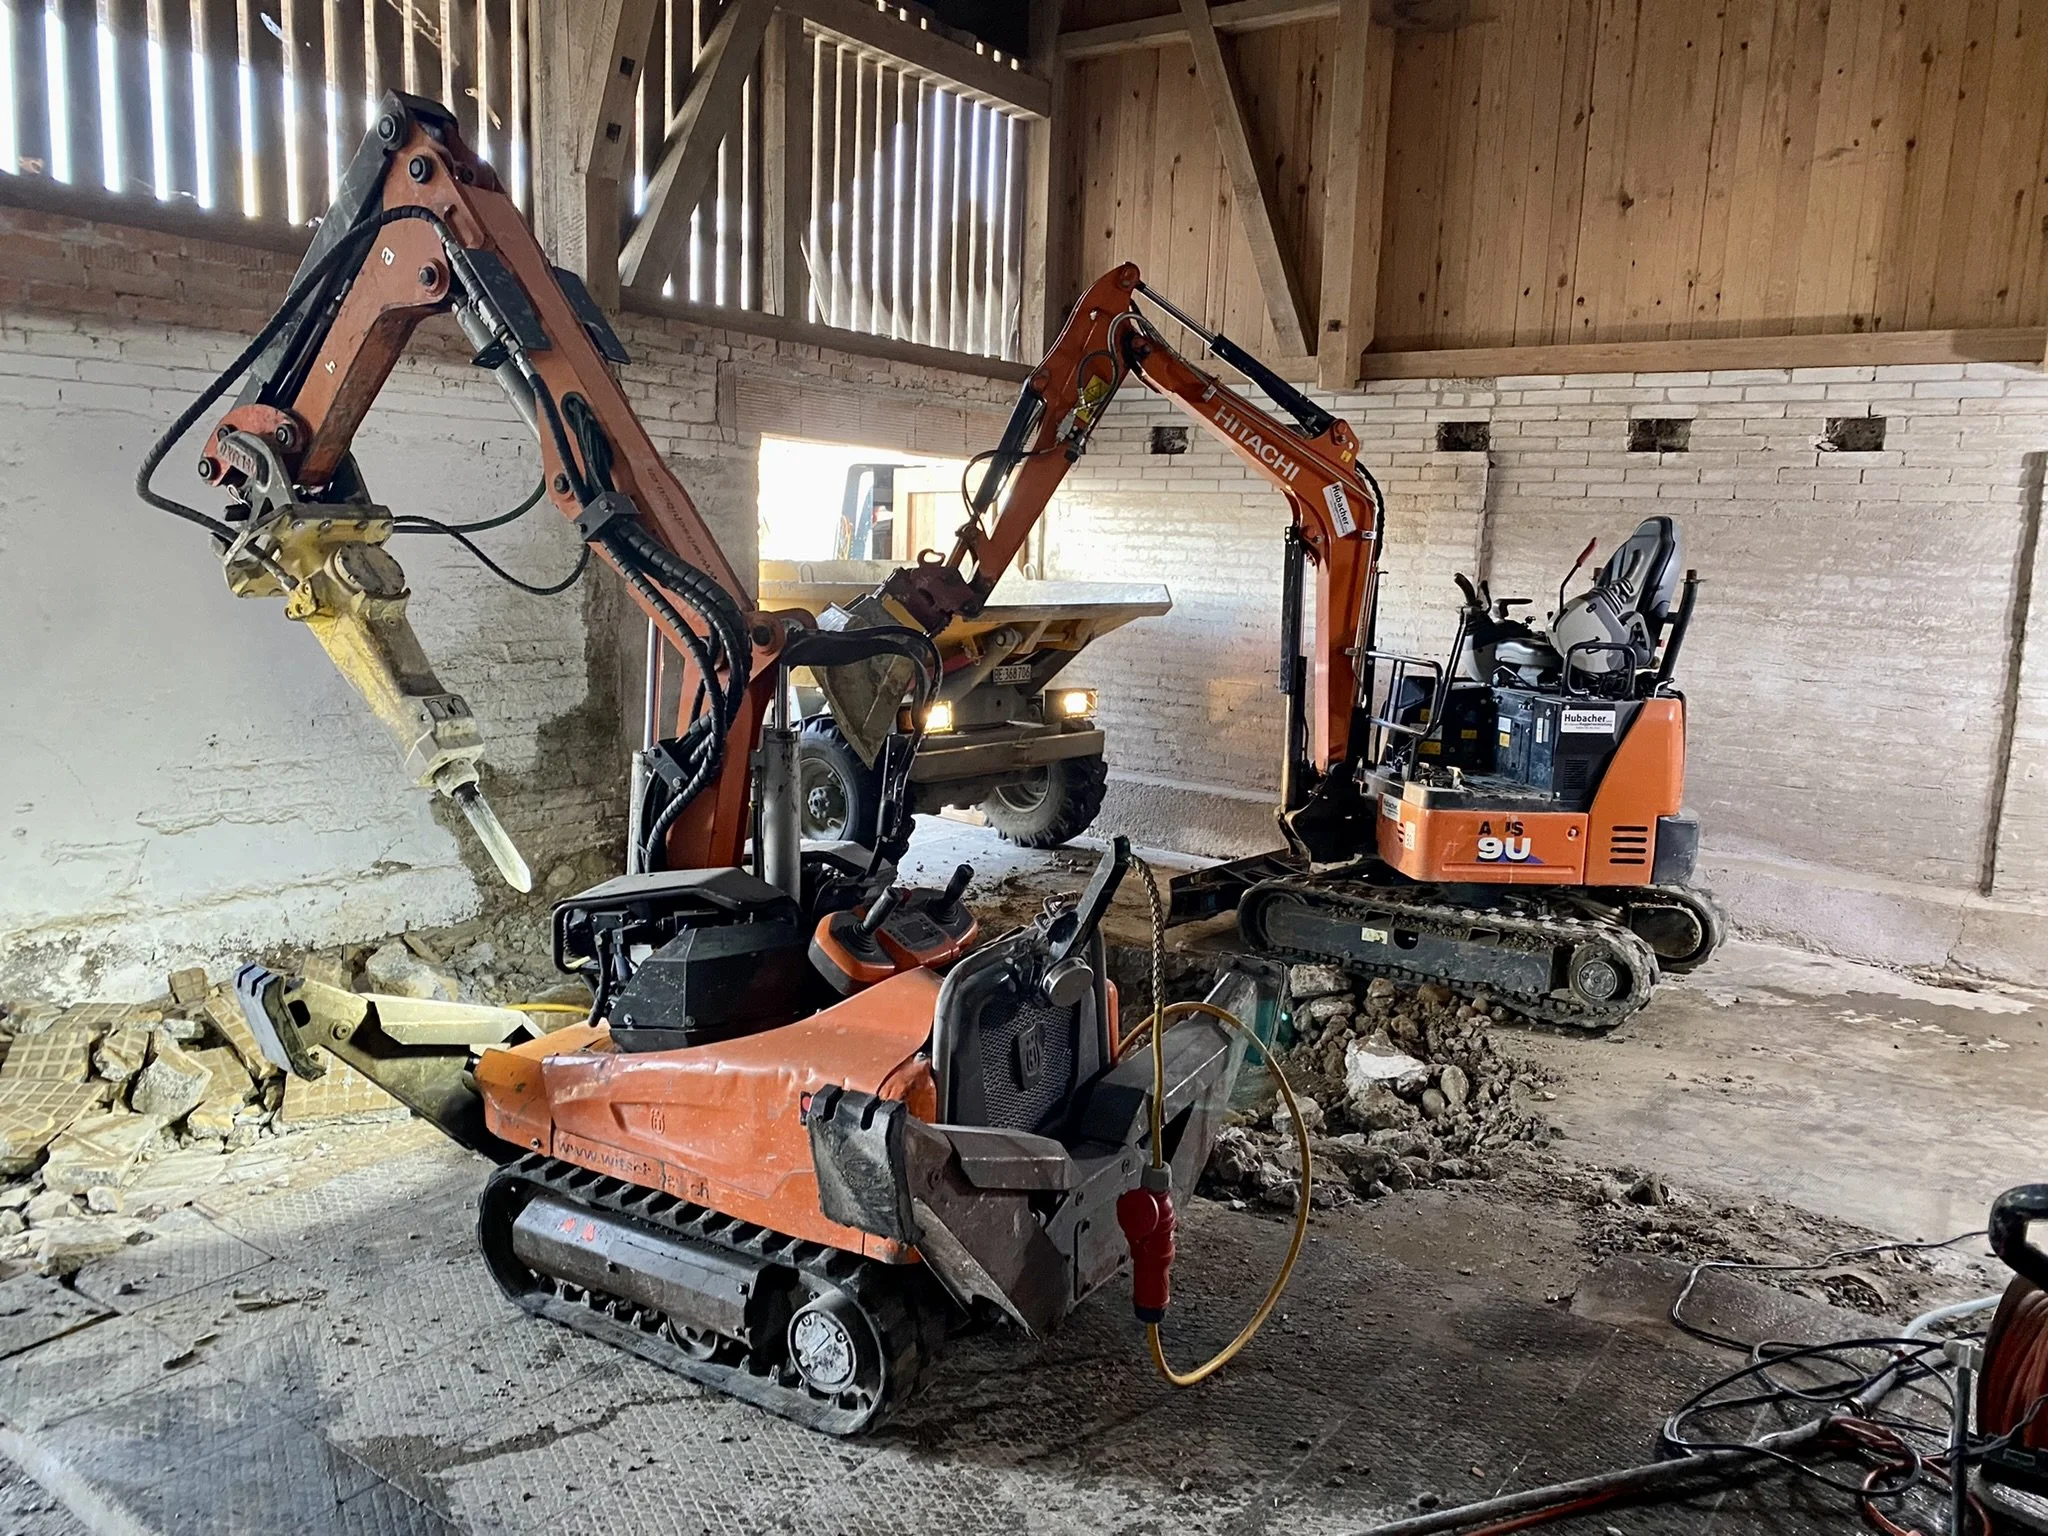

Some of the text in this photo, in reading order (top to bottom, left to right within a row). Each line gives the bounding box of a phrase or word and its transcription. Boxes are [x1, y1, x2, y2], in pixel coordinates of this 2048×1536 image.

[1213, 405, 1300, 482] HITACHI
[1332, 484, 1349, 525] Hubacher
[1564, 714, 1606, 723] Hubacher
[1477, 837, 1532, 862] 9U
